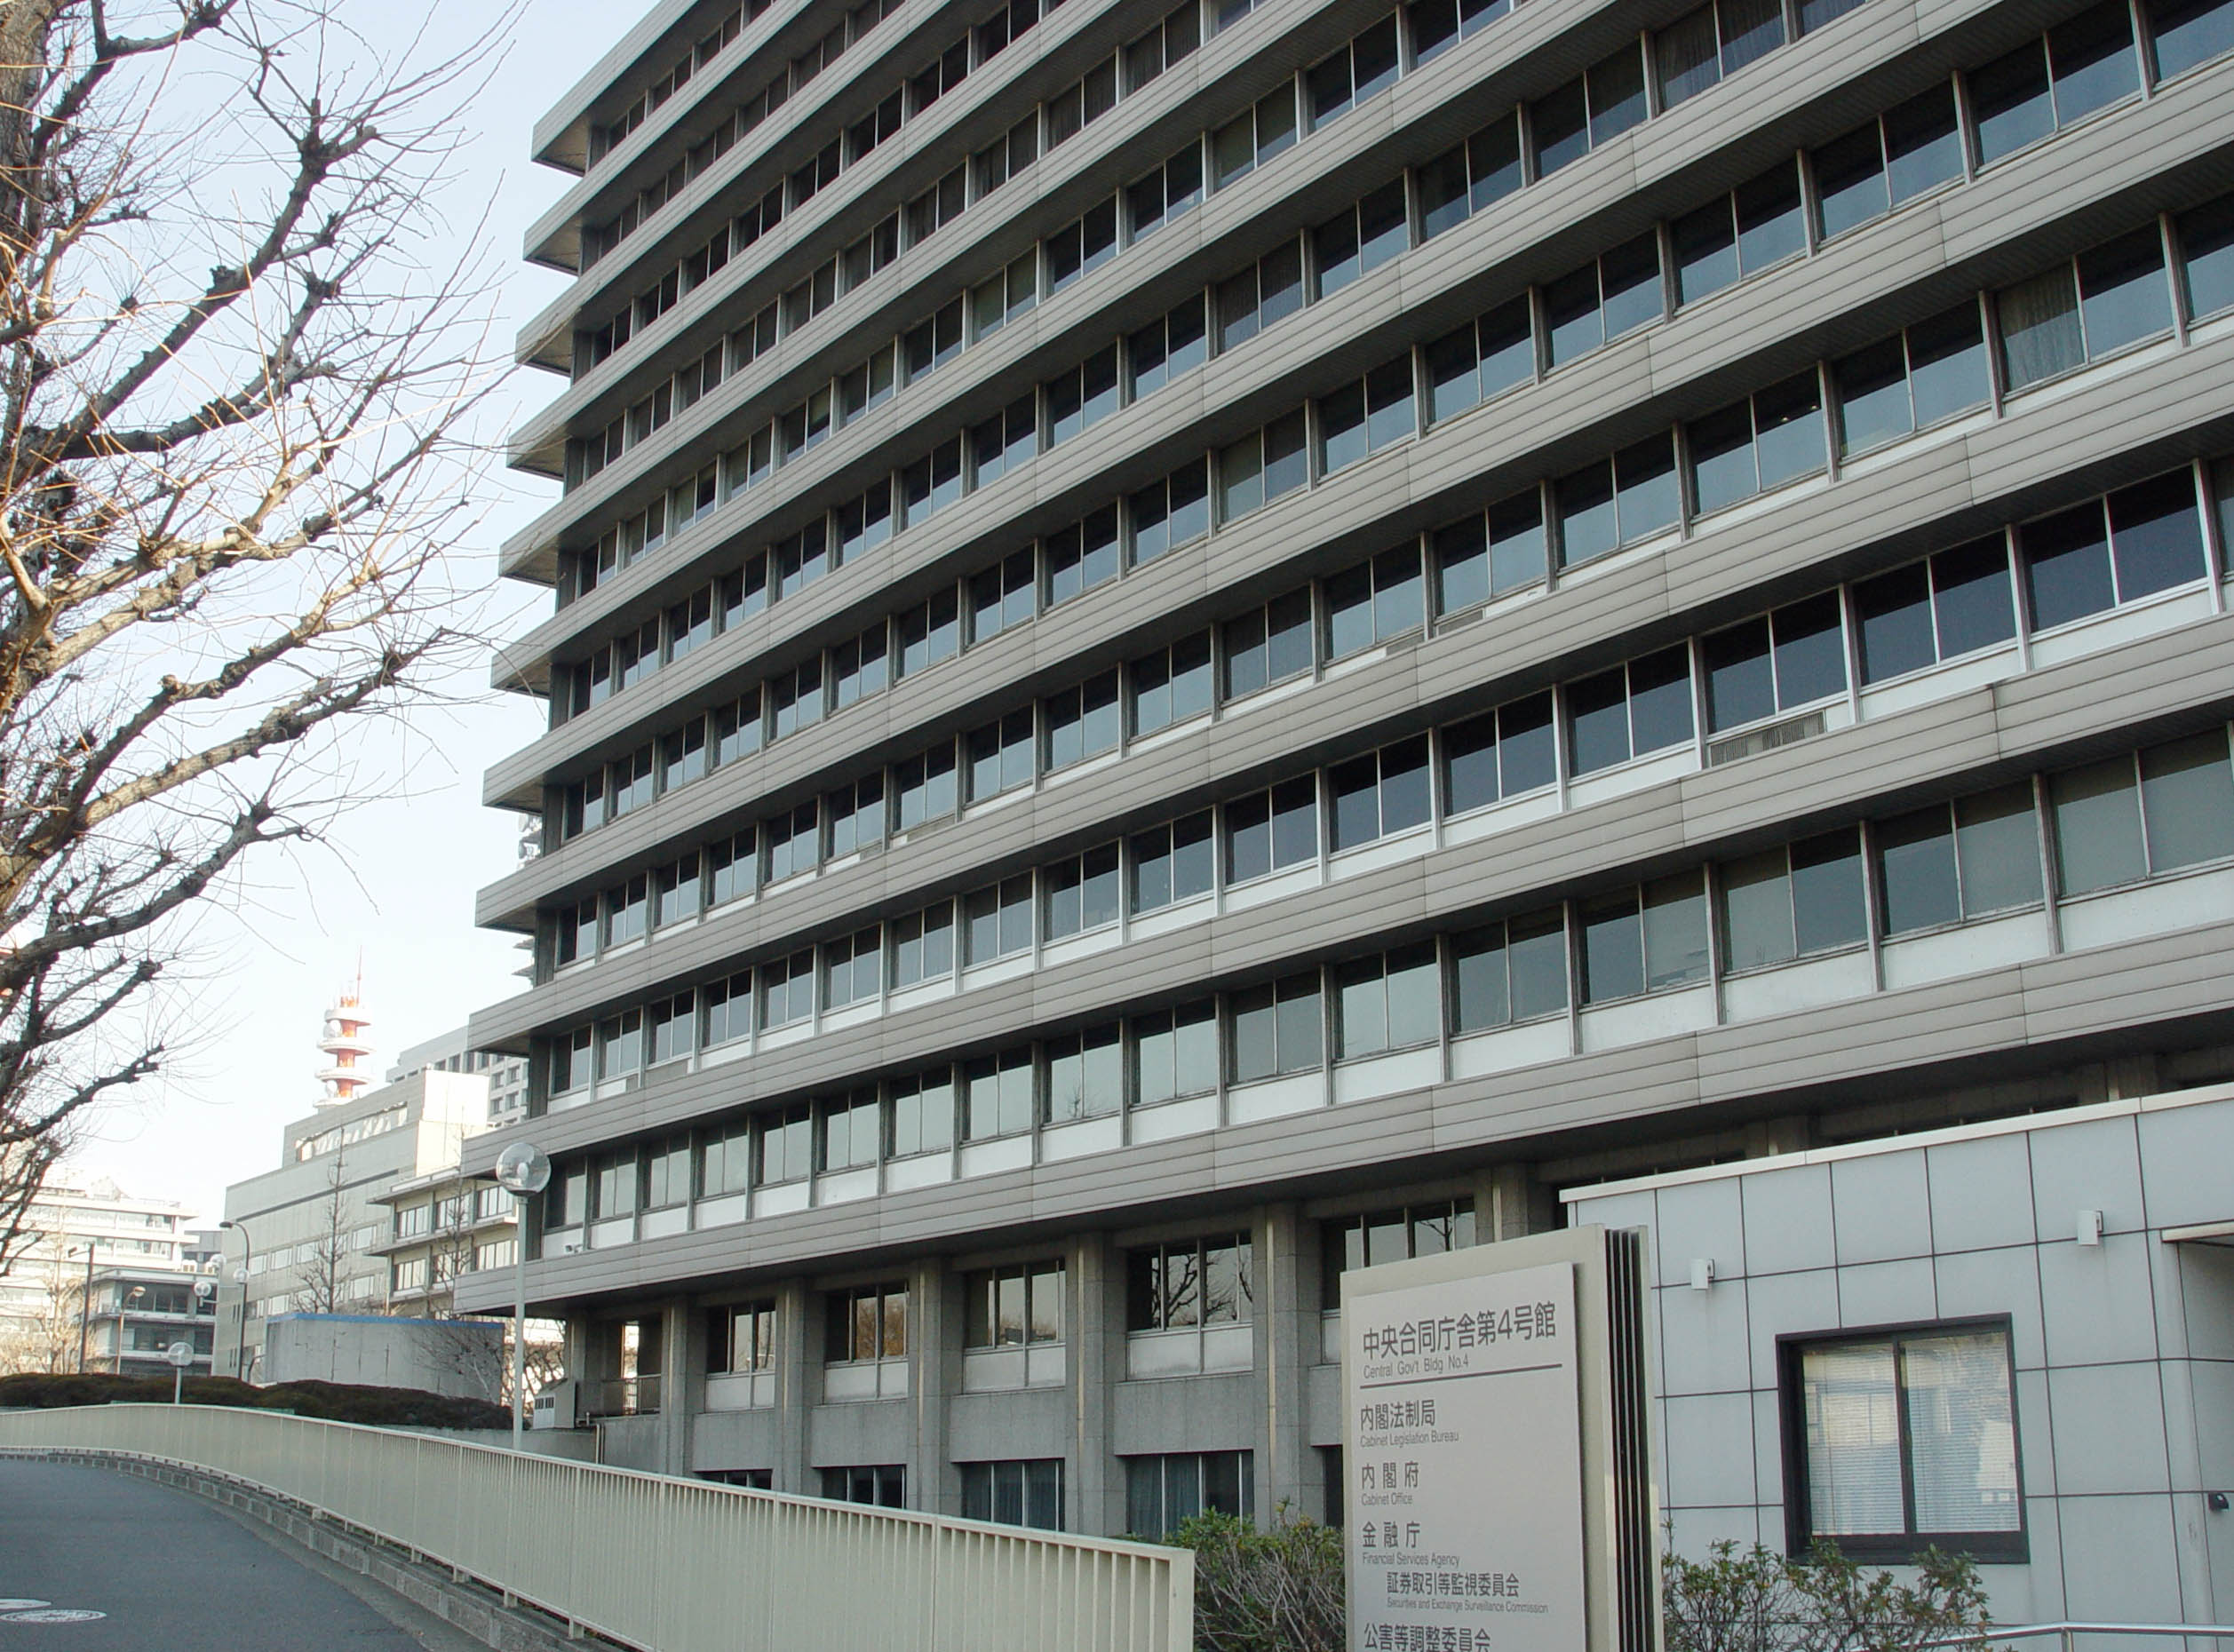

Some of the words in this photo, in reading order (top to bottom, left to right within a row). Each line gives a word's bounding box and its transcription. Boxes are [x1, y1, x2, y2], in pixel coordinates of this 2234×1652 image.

[1363, 1301, 1556, 1361] 中央合同庁舎第4号館
[1363, 1362, 1393, 1378] Central
[1423, 1357, 1443, 1374] Bldg
[1360, 1399, 1436, 1432] 内閣法制局
[1360, 1434, 1387, 1448] Cabinet
[1389, 1432, 1429, 1449] Legislation
[1431, 1429, 1459, 1443] Bureau
[1361, 1460, 1419, 1489] 内閣府
[1361, 1493, 1389, 1505] Cabinet
[1391, 1492, 1413, 1505] Office
[1362, 1521, 1420, 1548] 金融庁
[1362, 1552, 1395, 1565] Financial
[1396, 1552, 1429, 1565] Services
[1431, 1553, 1460, 1569] Agency
[1387, 1571, 1520, 1598] 証券取引等監視委員会
[1387, 1597, 1417, 1609] Securities
[1419, 1599, 1430, 1608] and
[1431, 1599, 1463, 1612] Exchange
[1465, 1600, 1505, 1612] Surveillance
[1506, 1600, 1549, 1614] Commission
